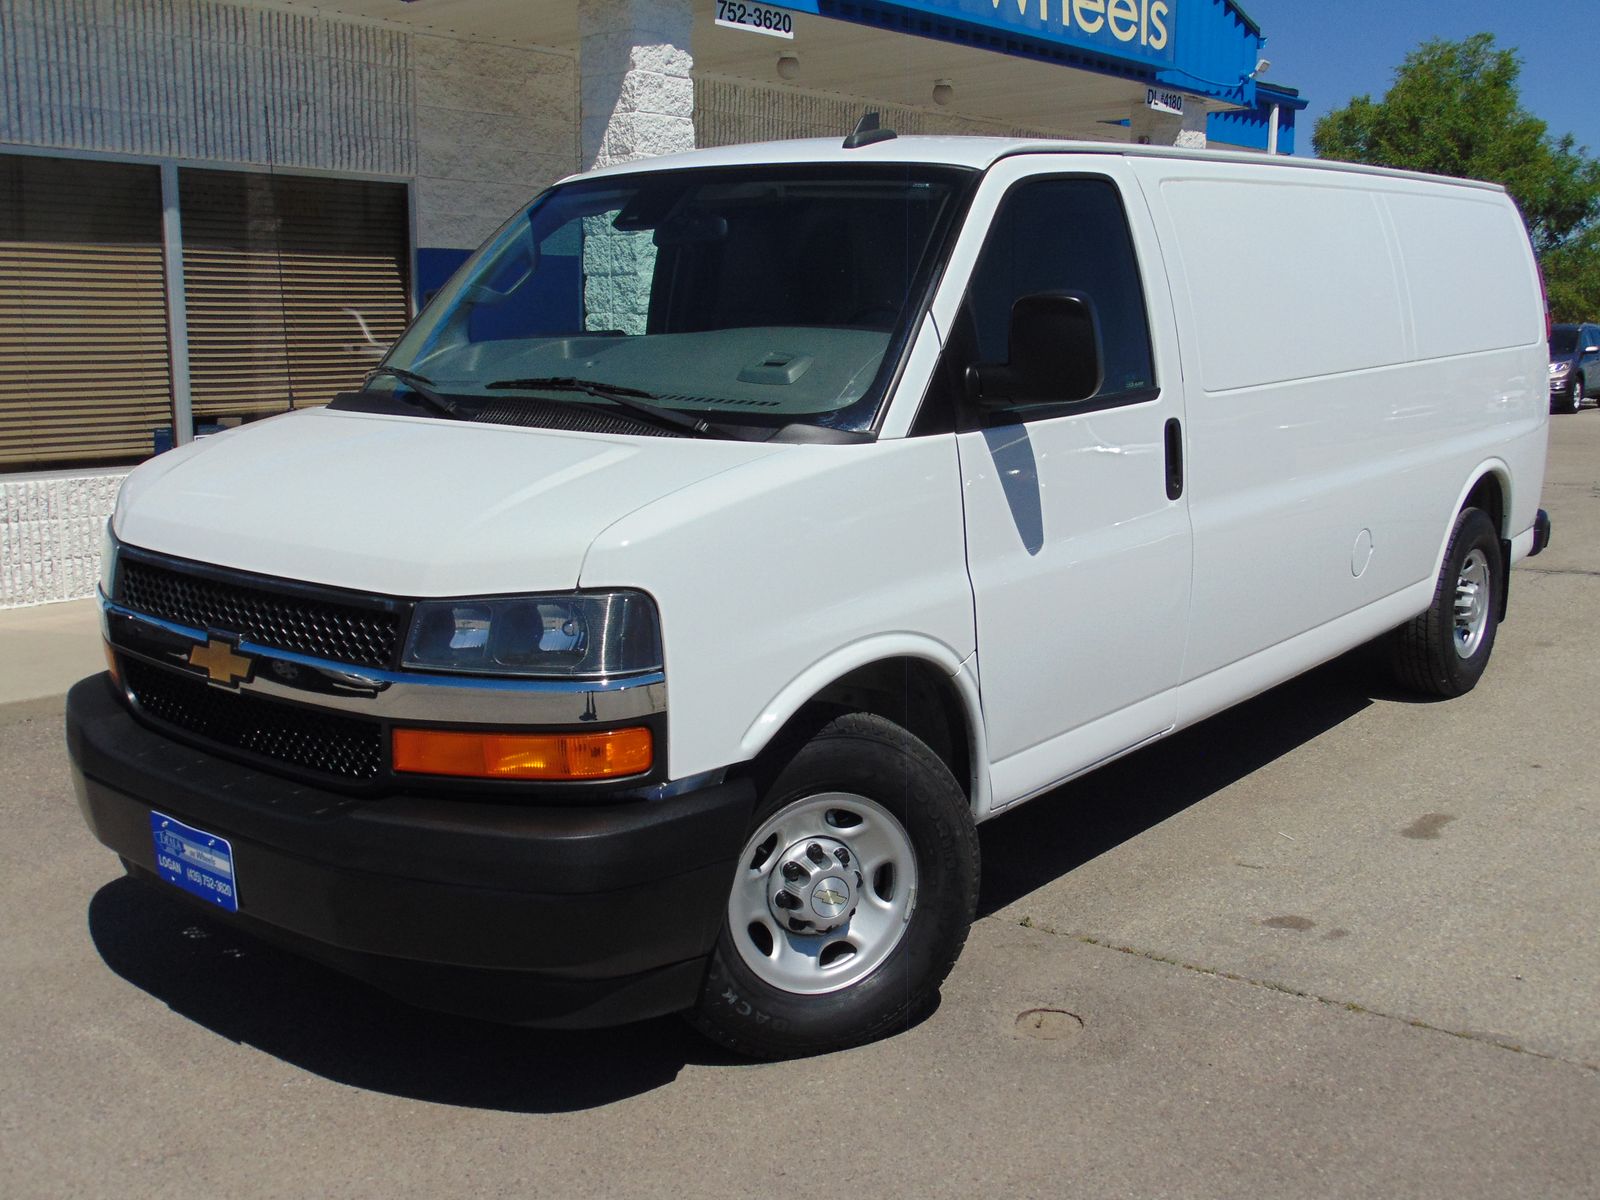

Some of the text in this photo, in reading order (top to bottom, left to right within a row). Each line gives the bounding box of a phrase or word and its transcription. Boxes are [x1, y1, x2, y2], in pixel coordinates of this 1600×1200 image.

[717, 0, 792, 33] 752-3620
[991, 0, 1168, 50] eels
[1147, 88, 1159, 105] DL
[158, 853, 182, 875] LOGAN
